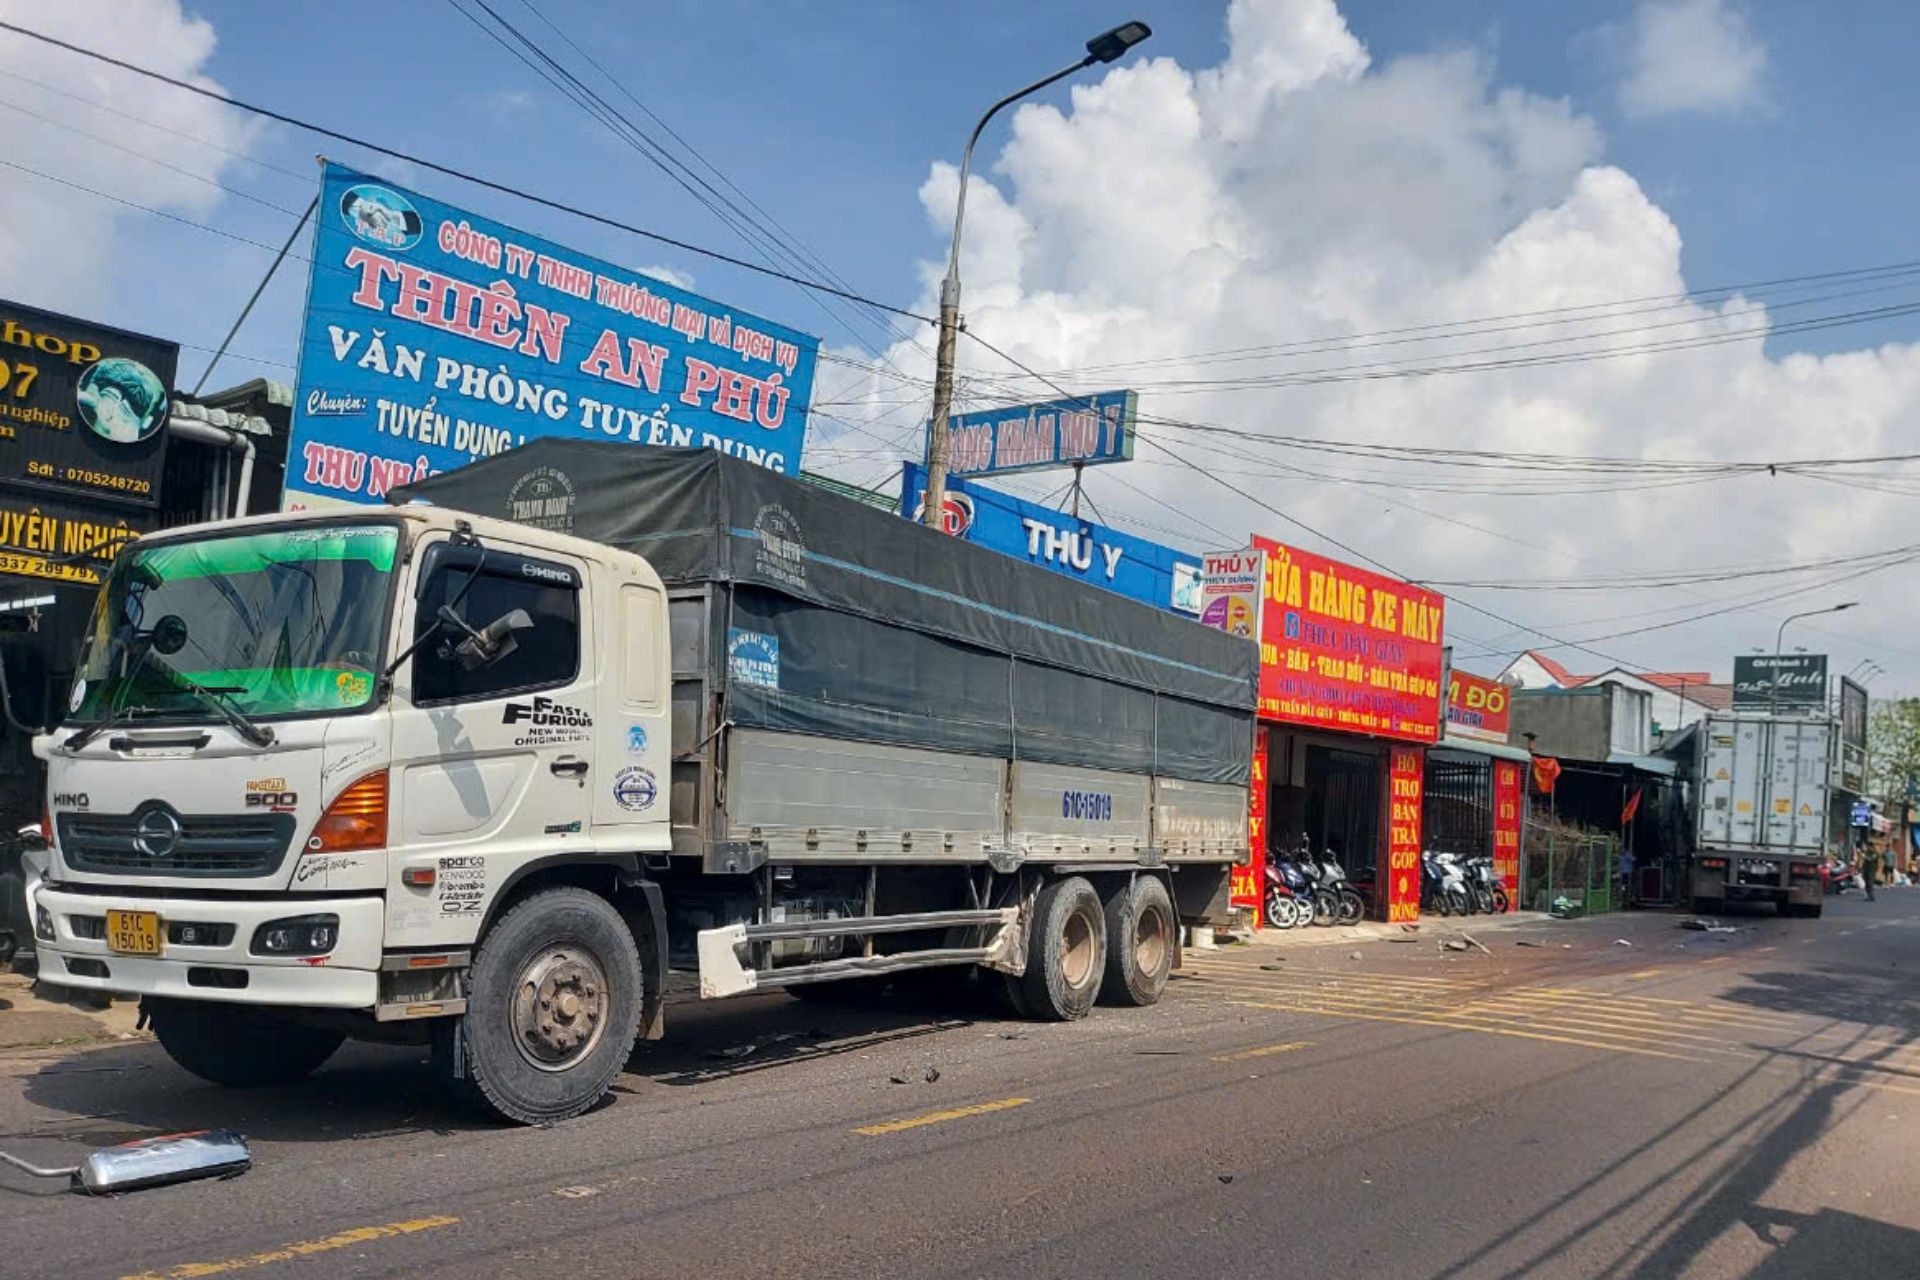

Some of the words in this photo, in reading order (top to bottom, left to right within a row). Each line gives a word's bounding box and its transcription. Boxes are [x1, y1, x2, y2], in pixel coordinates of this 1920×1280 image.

[438, 221, 501, 269] CÔNG
[505, 243, 534, 278] TY
[537, 255, 593, 300] TNHH
[596, 275, 671, 327] THƯƠNG
[672, 303, 707, 343] MẠI
[734, 325, 774, 362] DỊCH
[776, 340, 798, 376] VỤ
[345, 247, 570, 364] THIÊN
[580, 329, 669, 394] AN
[680, 356, 790, 430] PHÚ
[328, 325, 426, 382] VĂN
[434, 356, 569, 420] PHÒNG
[579, 397, 693, 447] TUYỂN
[376, 396, 450, 447] TUYỂN
[304, 441, 367, 492] THU
[367, 455, 444, 498] NH
[67, 468, 150, 493] 0705248720
[1023, 519, 1093, 570] THÚ
[1102, 543, 1123, 579] Y
[537, 566, 571, 582] HINO
[1206, 554, 1241, 574] THÚ
[1245, 557, 1258, 572] Y
[1309, 566, 1366, 624] HÀNG
[1371, 589, 1397, 632] XE
[1402, 596, 1441, 644] MÁY
[1260, 643, 1277, 666] UA
[1287, 646, 1309, 672] BÁN
[502, 703, 593, 727] FURIOUS
[534, 696, 581, 716] FAST
[515, 736, 567, 746] ORIGINAL
[529, 728, 553, 736] NEW
[54, 793, 90, 806] HINO
[245, 792, 298, 807] 500
[1394, 779, 1419, 802] TRỢ
[1393, 800, 1417, 820] BÁN
[439, 857, 484, 869] sparco
[1391, 847, 1416, 869] GÓP
[440, 870, 485, 880] KENWOOD
[442, 901, 481, 911] OZ
[121, 914, 143, 931] 61C
[115, 932, 154, 951] 150.19
